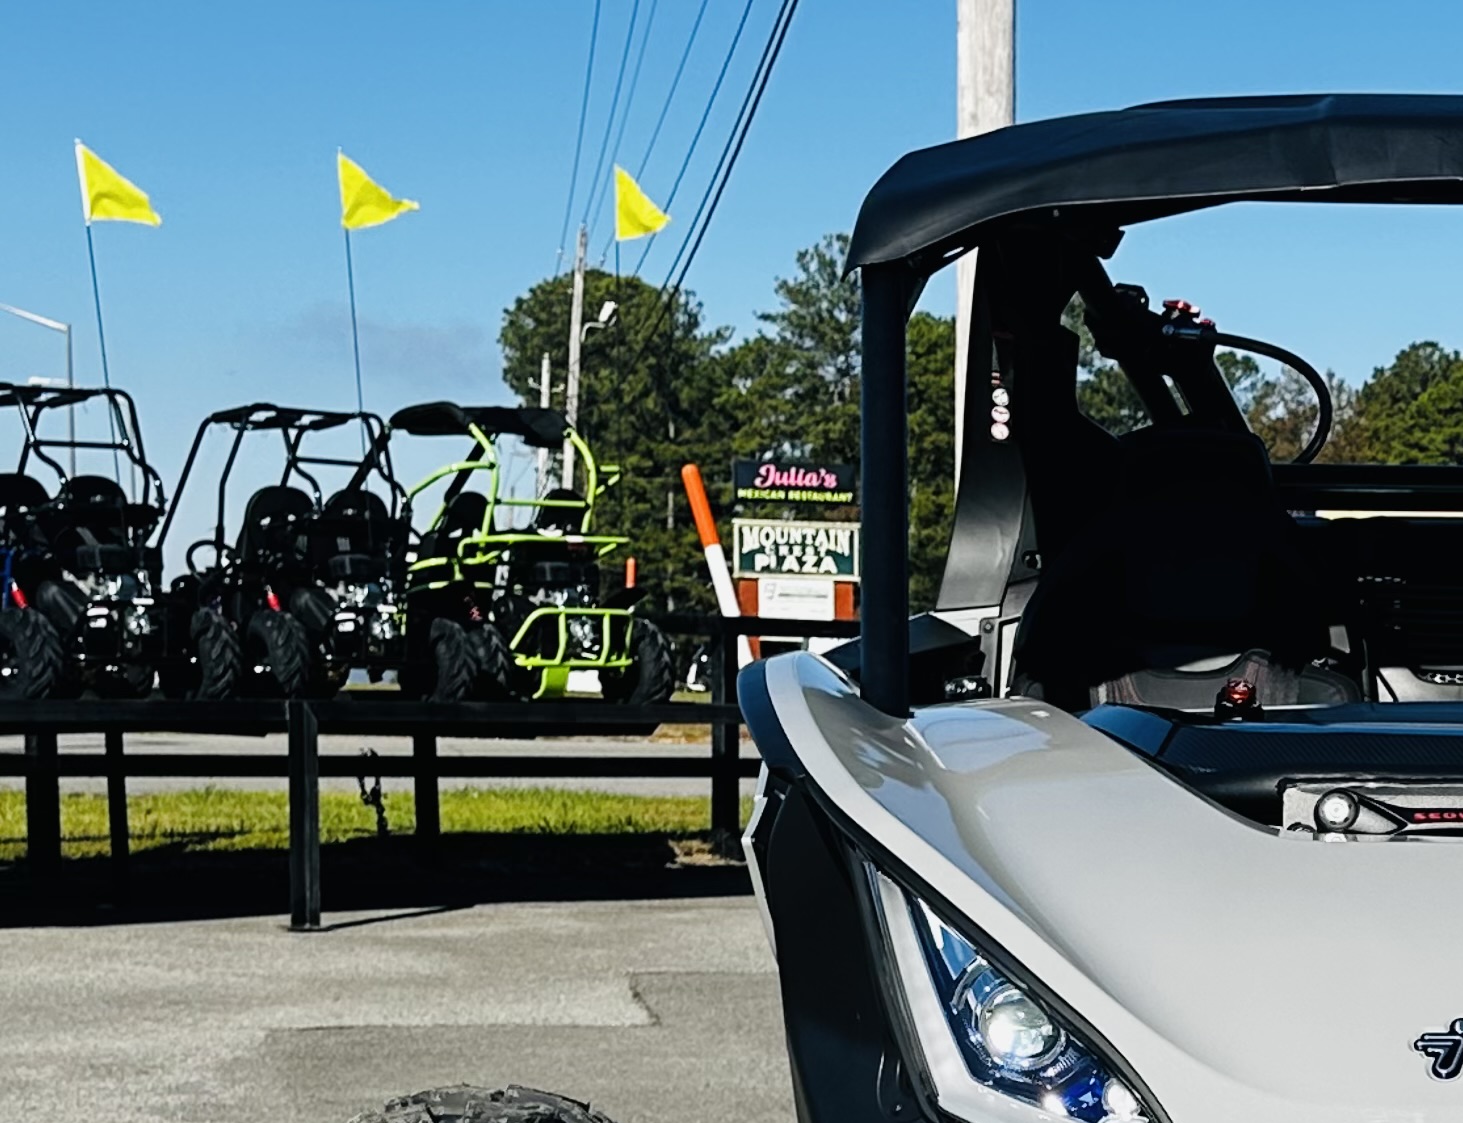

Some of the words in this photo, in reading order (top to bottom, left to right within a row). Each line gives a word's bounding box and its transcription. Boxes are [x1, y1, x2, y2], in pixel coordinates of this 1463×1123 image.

[754, 464, 838, 488] Julia's
[737, 488, 786, 500] MEXICAN
[788, 490, 853, 502] RESTAURANT
[741, 526, 851, 557] MOUNTAIN
[754, 553, 838, 574] PLAZA
